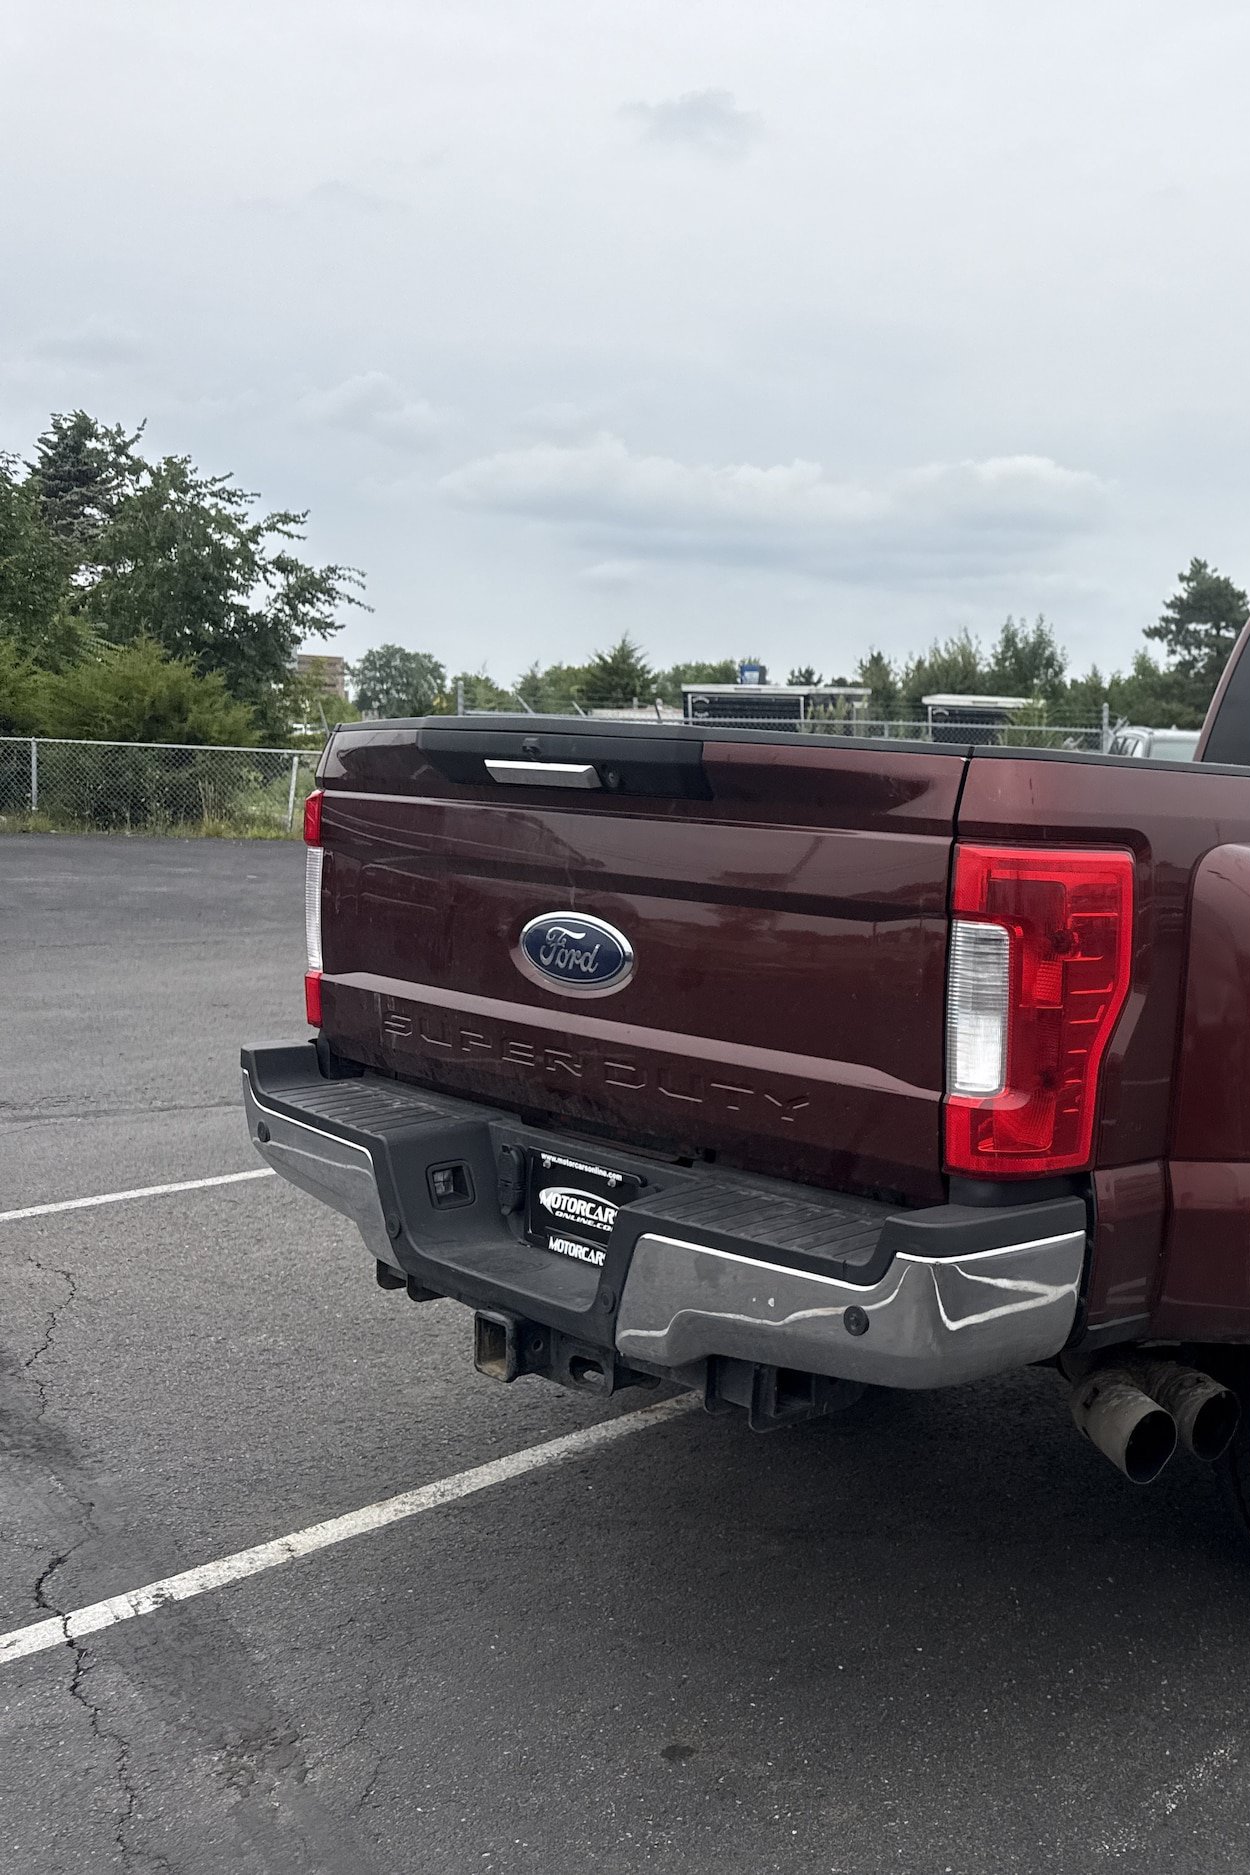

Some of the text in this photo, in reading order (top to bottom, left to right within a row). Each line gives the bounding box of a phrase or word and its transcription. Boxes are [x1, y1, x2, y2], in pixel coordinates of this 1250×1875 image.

[539, 926, 601, 973] Ford
[383, 1013, 810, 1122] SUPER DUTY
[539, 1191, 618, 1225] MOTORCAR
[554, 1210, 613, 1232] ONLINE.CO
[548, 1235, 606, 1267] MOTORCAR
